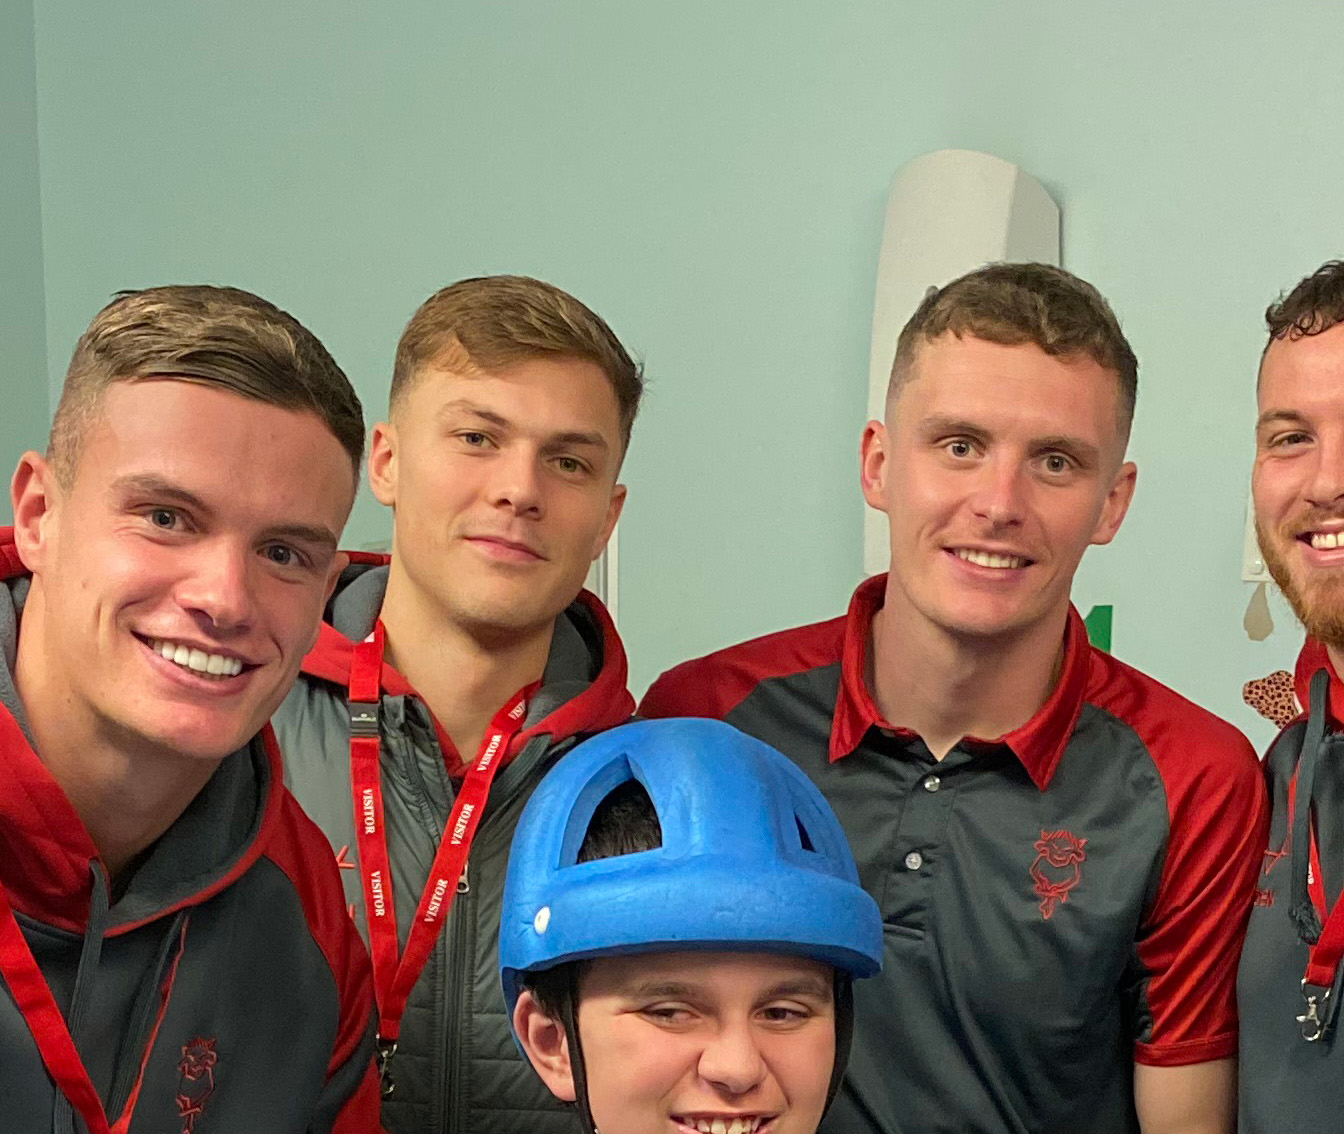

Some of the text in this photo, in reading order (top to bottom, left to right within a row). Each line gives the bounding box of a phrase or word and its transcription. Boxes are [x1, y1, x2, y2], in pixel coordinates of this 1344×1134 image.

[477, 734, 502, 772] VISITOR
[362, 788, 375, 835] VISITOR
[451, 803, 475, 846] VISITOR
[370, 871, 385, 917] VISITOR
[424, 878, 449, 923] VISITOR
